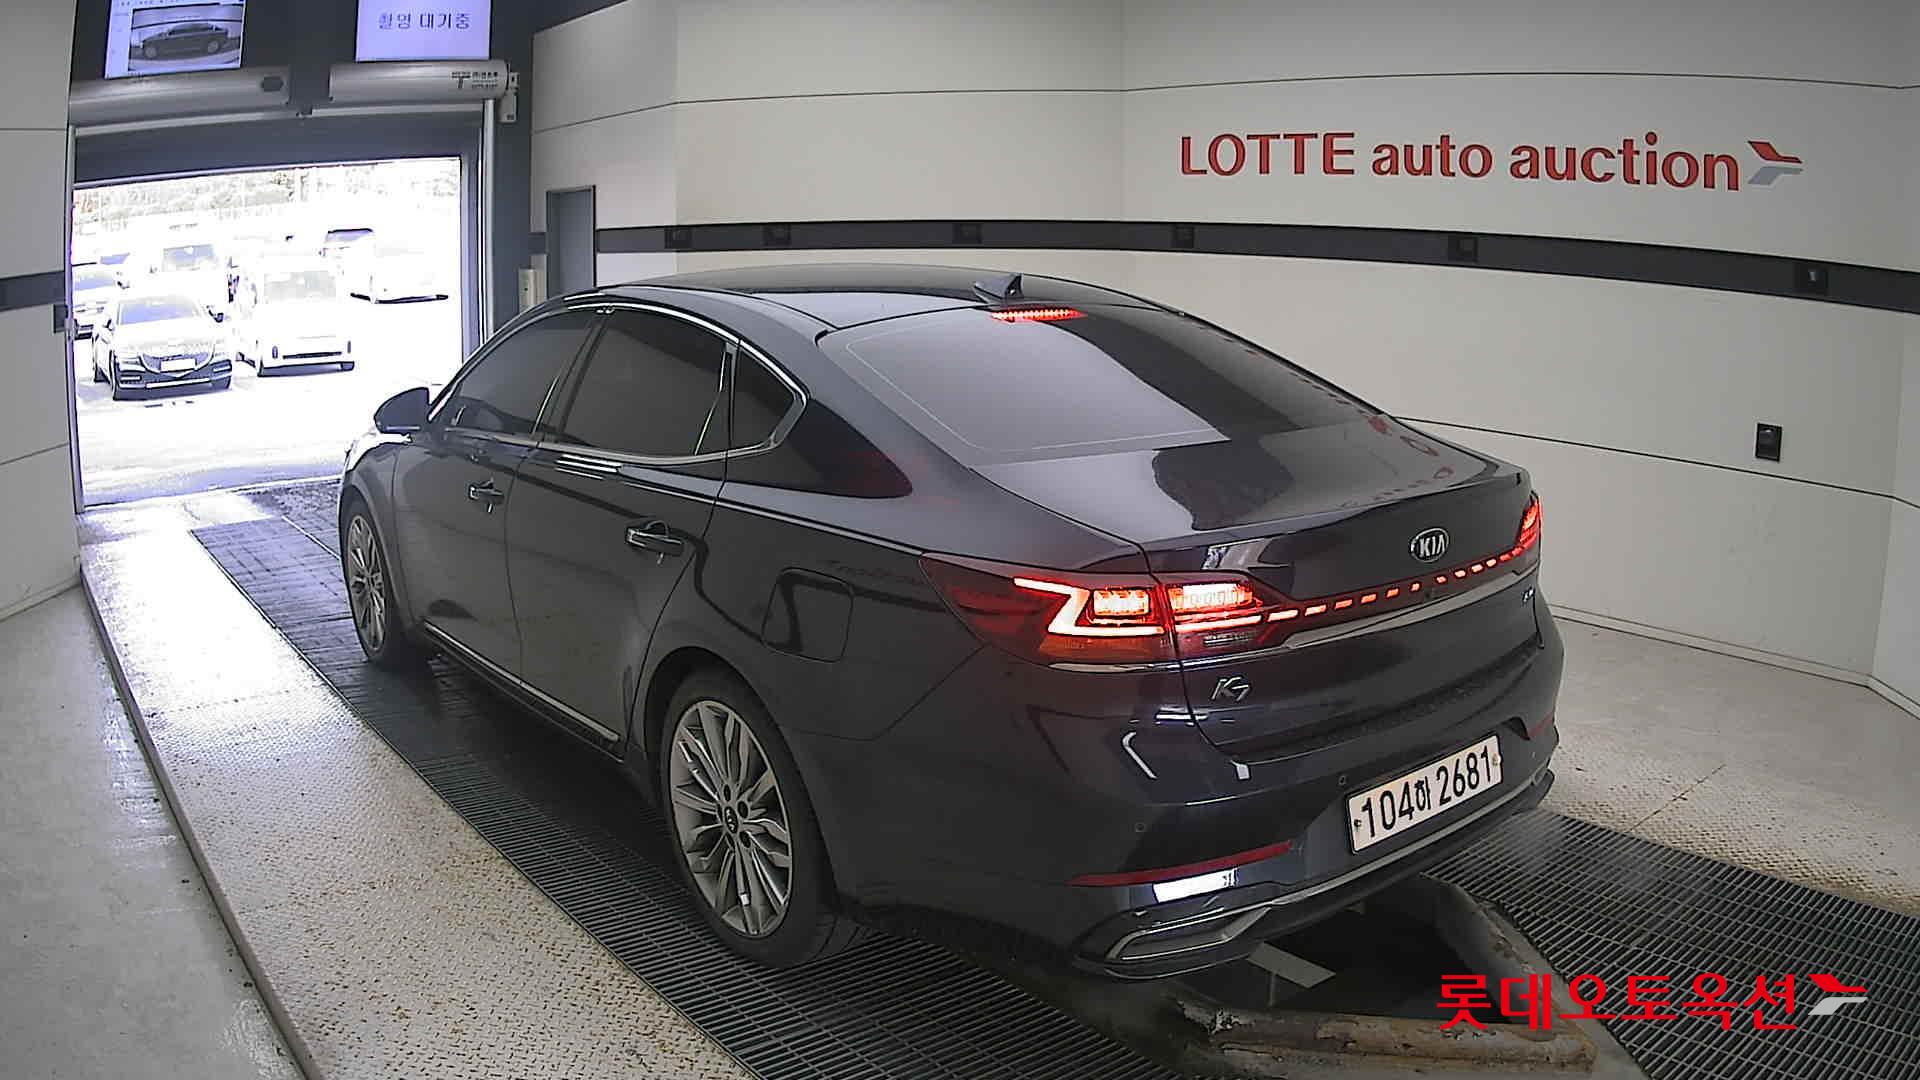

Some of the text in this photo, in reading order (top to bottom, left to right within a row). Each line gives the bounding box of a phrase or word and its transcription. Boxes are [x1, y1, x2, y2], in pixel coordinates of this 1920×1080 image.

[420, 13, 470, 29] 대기중
[1181, 131, 1740, 191] LOTTE auto auction
[1211, 676, 1249, 702] K7
[1361, 745, 1491, 838] 104하 2681
